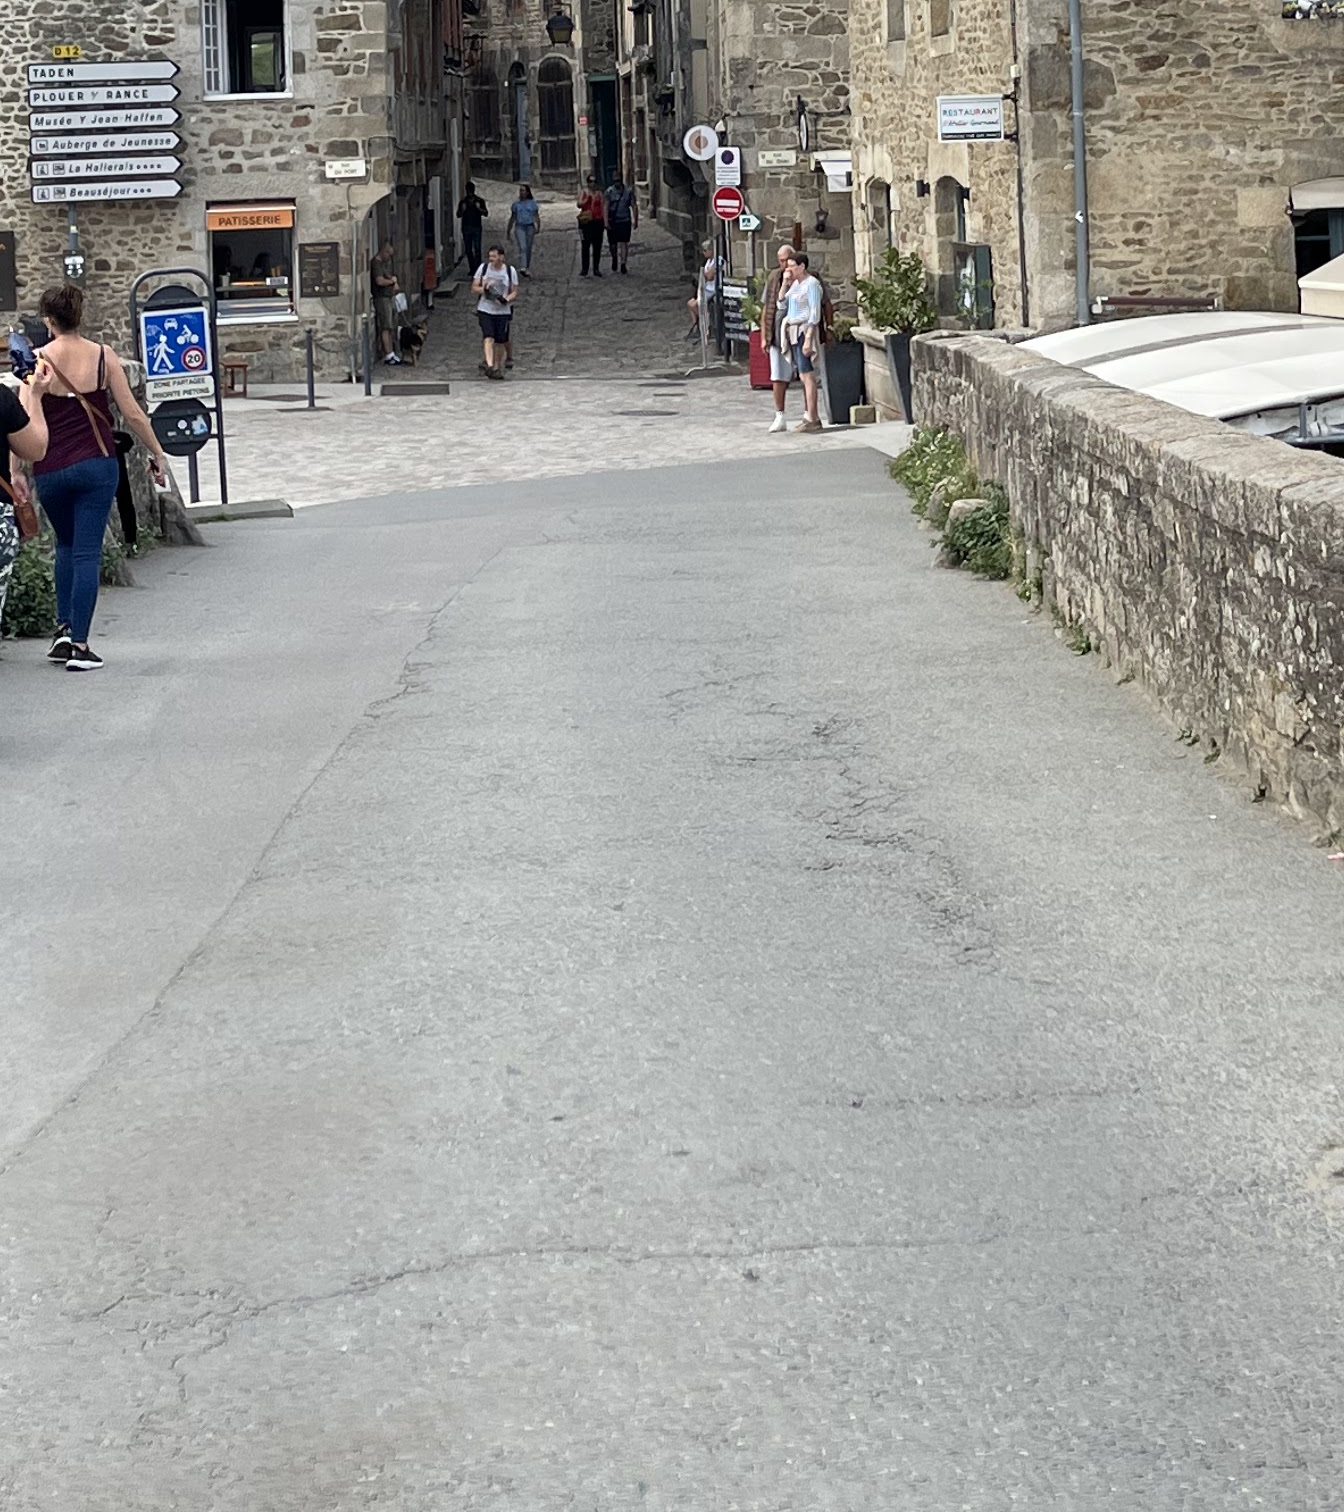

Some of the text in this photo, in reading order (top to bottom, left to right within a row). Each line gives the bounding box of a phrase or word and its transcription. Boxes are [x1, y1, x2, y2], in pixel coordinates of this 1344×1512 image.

[55, 46, 79, 56] D 12
[32, 68, 74, 78] TADEN
[33, 91, 84, 102] PLOUER
[106, 89, 149, 99] RANCE
[942, 108, 998, 117] RESTAURANT
[34, 117, 72, 127] Musée
[52, 137, 172, 151] Auberge de Jeunesse
[68, 164, 81, 174] La
[69, 186, 131, 198] Beauséjour
[218, 215, 281, 226] PATISSERIE
[187, 353, 201, 364] 20
